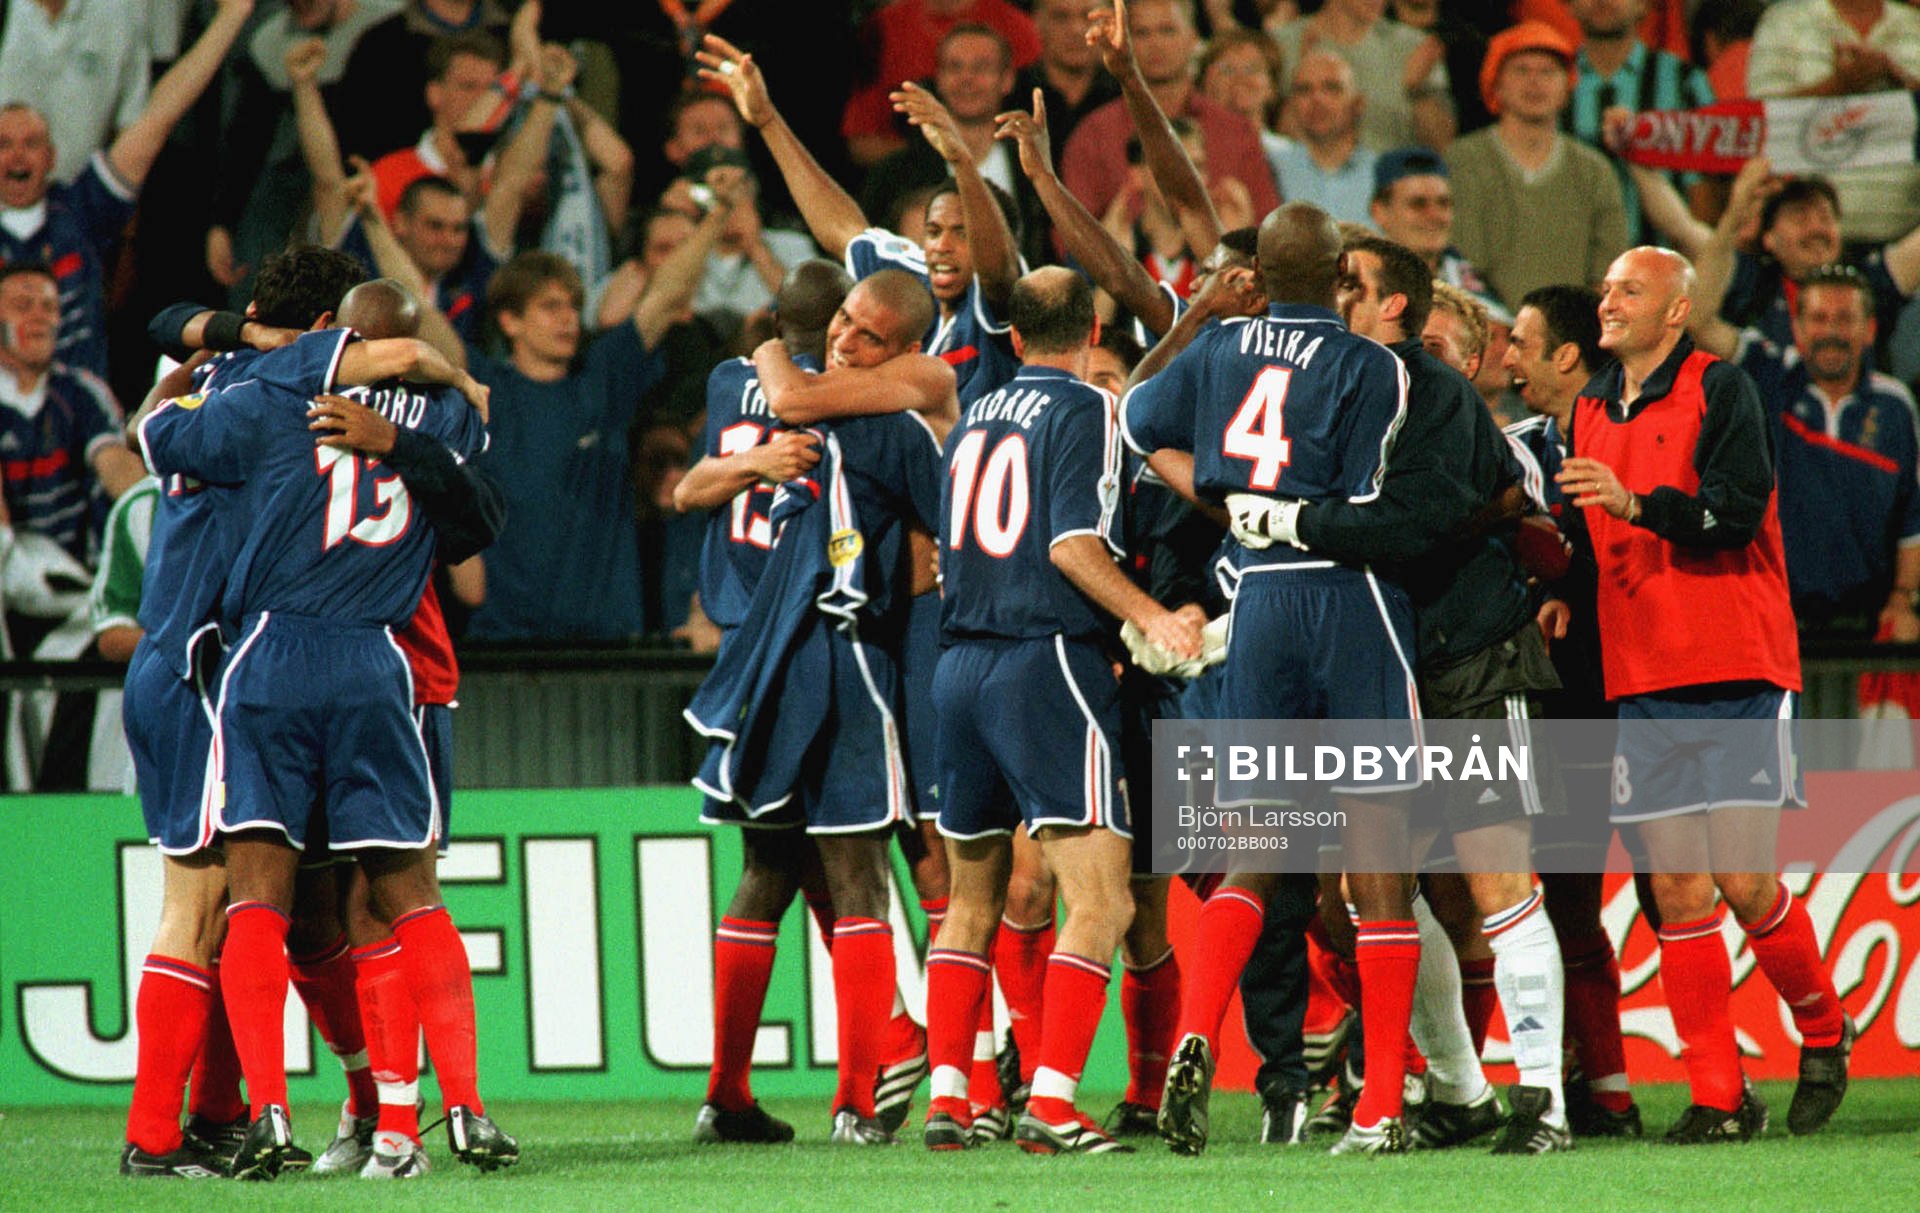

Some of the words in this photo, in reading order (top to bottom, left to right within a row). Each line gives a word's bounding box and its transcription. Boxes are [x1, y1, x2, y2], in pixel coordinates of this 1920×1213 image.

[1626, 112, 1762, 158] FRANC
[1240, 318, 1324, 370] VIEIRA
[966, 387, 1051, 430] ZIDANE
[1222, 364, 1293, 491] 4
[950, 429, 1030, 559] 10
